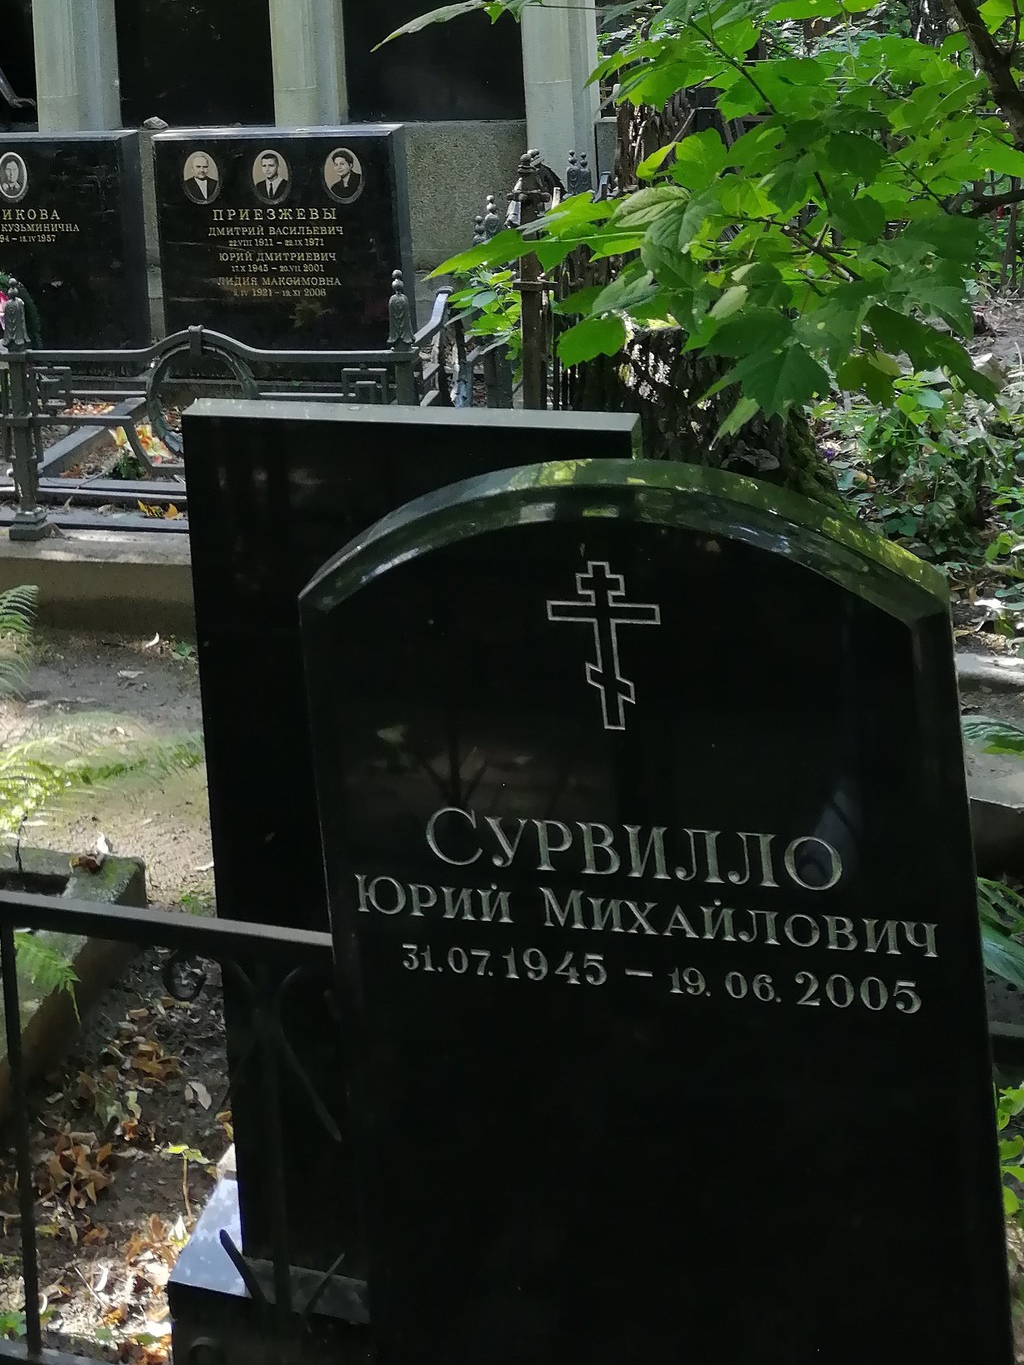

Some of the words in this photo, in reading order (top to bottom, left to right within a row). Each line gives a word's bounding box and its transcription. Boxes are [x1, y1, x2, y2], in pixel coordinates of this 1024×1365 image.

[212, 207, 337, 221] ПРИЕЗЖЕВЫ
[1, 223, 80, 233] КУЗЬМИНИЧНА
[208, 225, 265, 237] ДМИТРИЙ
[268, 225, 344, 235] ВАСИЛЬЕВИЧ
[304, 237, 325, 247] 1971
[219, 251, 253, 262] ЮРИЙ
[256, 252, 337, 262] ДМИТРИЕВИЧ
[302, 264, 325, 273] 2001
[262, 276, 342, 286] МАКСИМОВНА
[425, 806, 843, 891] СУРВИЛЛО
[354, 873, 515, 925] ЮРИЙ
[538, 885, 940, 958] МИХАЙЛОВИЧ
[794, 971, 923, 1014] 2005
